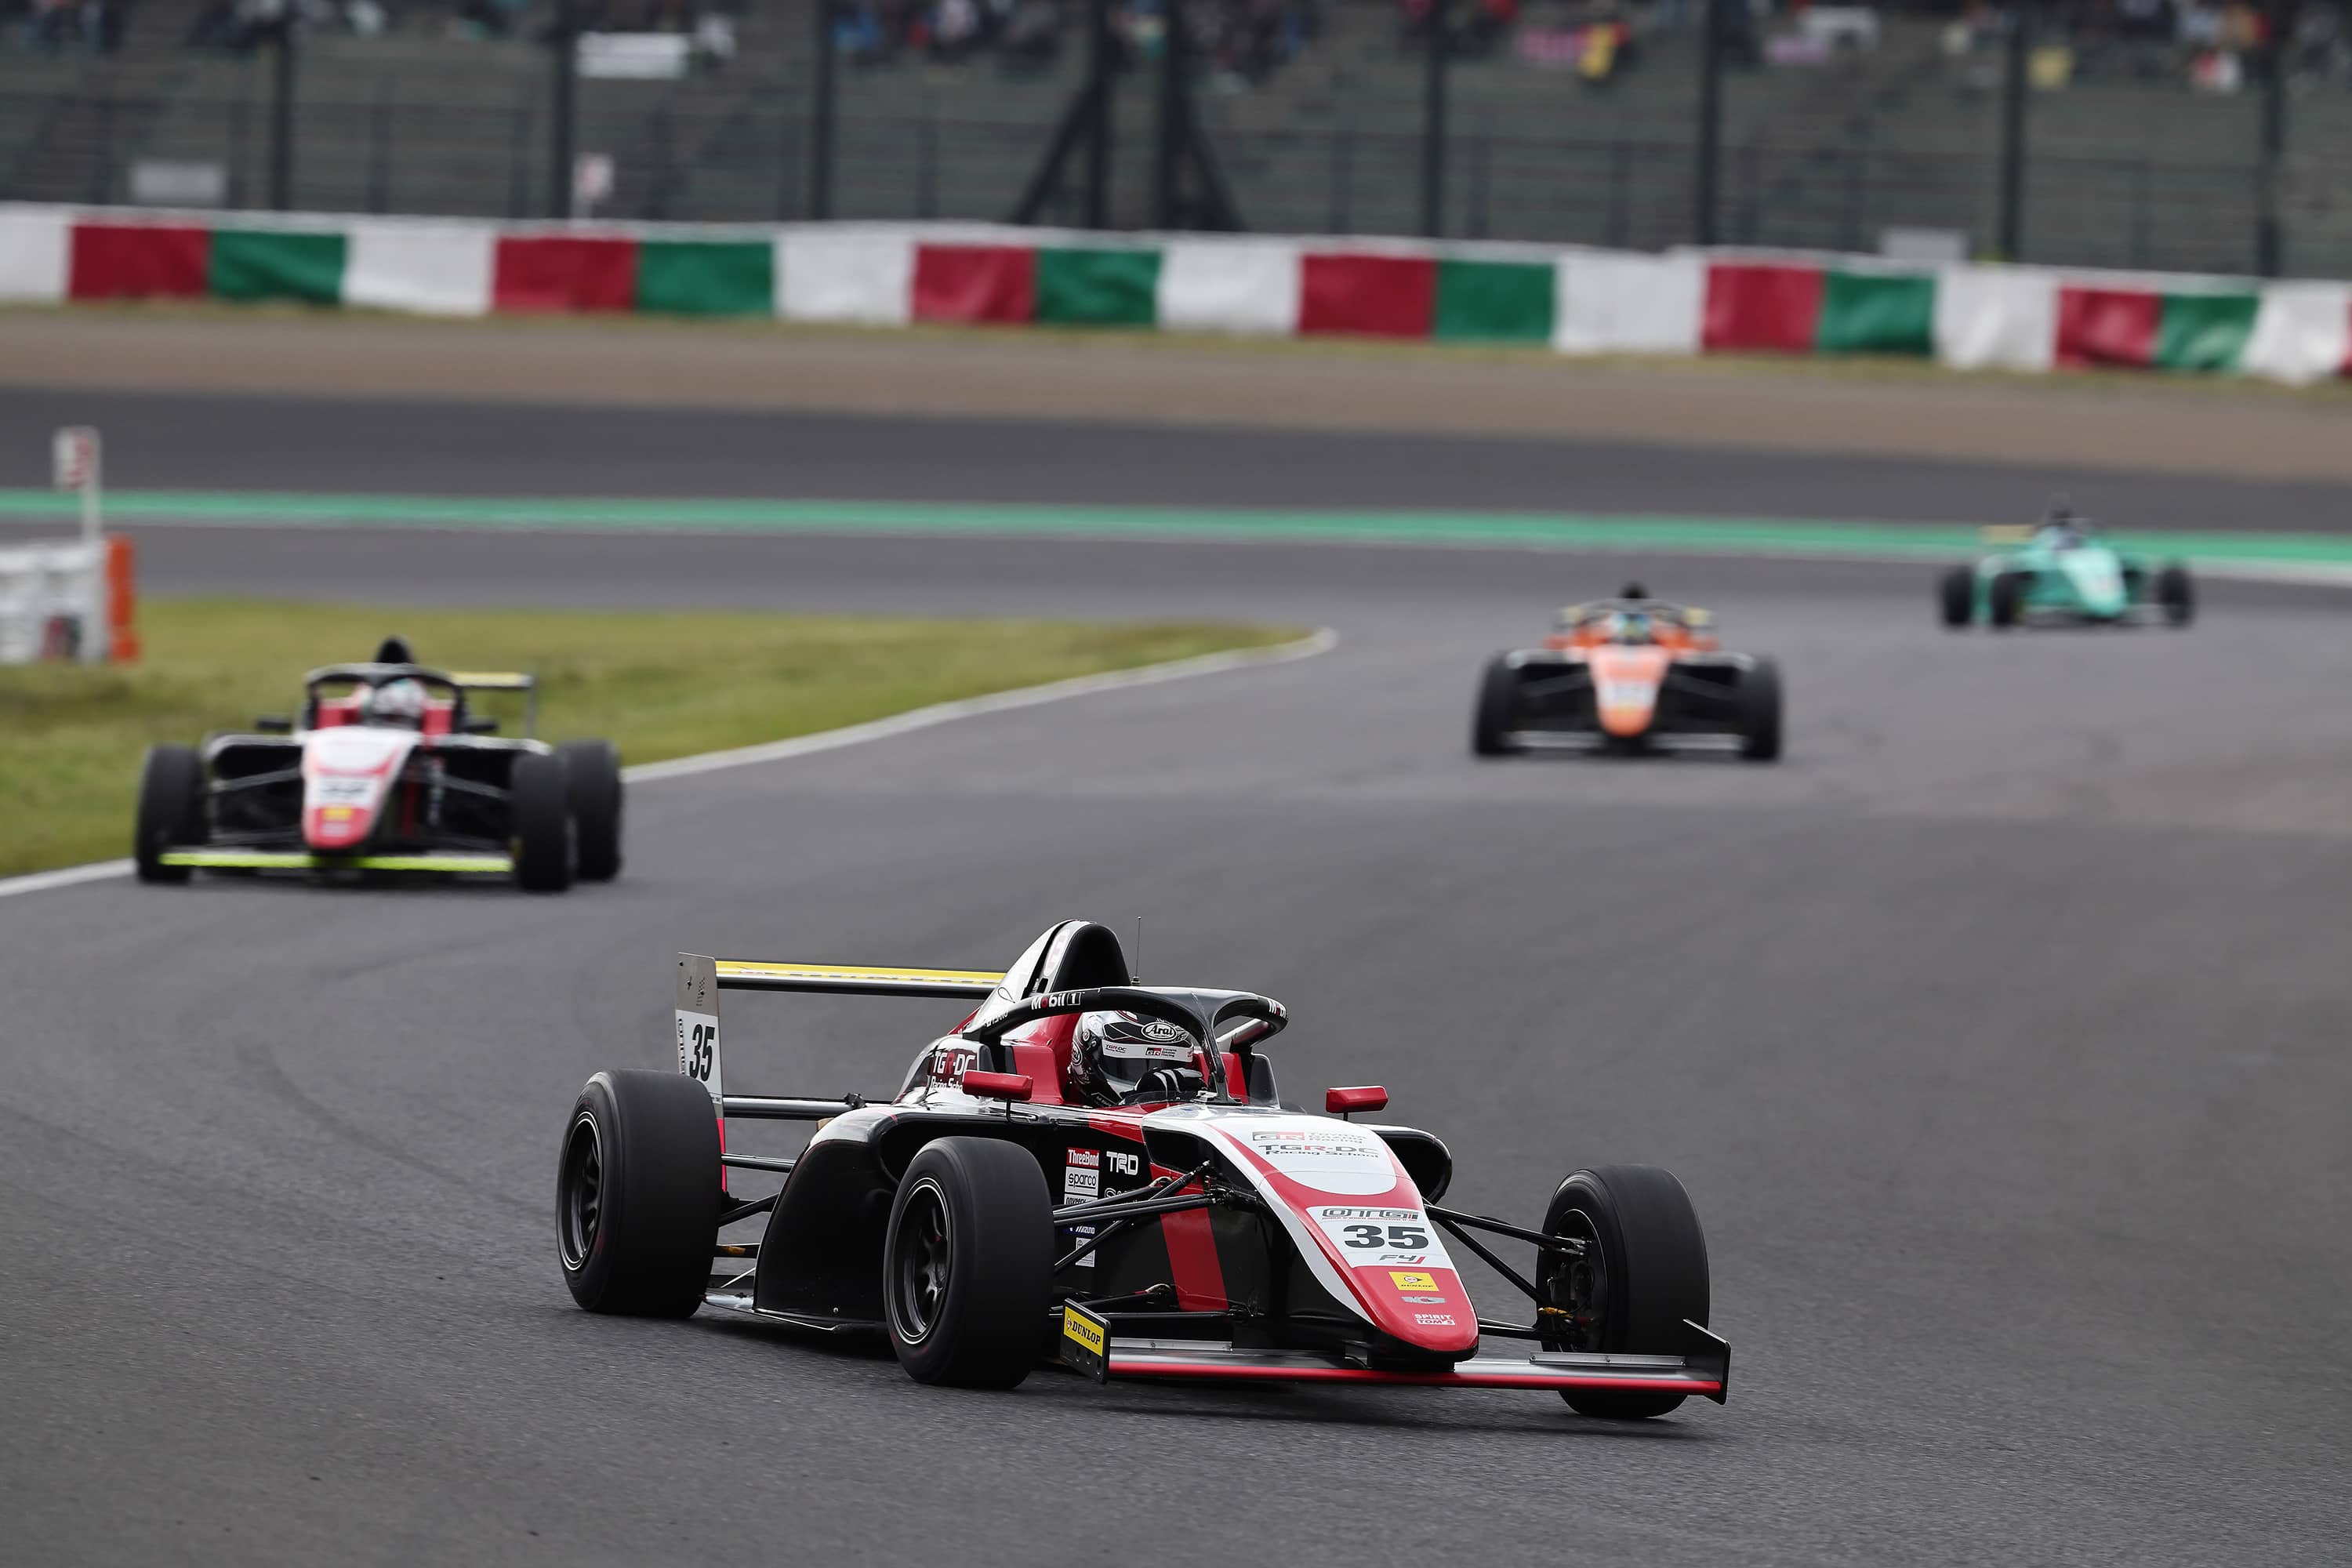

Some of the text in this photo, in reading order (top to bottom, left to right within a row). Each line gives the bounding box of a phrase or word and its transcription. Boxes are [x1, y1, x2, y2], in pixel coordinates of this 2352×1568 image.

[1031, 993, 1066, 1010] Mobil
[1145, 1024, 1174, 1036] Arai
[689, 1024, 715, 1082] 35
[948, 1077, 963, 1091] Scho
[1068, 1149, 1099, 1167] ThreeBond
[1258, 1144, 1379, 1155] TGR-DC
[1106, 1151, 1138, 1175] TRD
[1069, 1173, 1097, 1187] sparco
[1343, 1225, 1429, 1250] 35
[1072, 1321, 1101, 1345] DUNLOP
